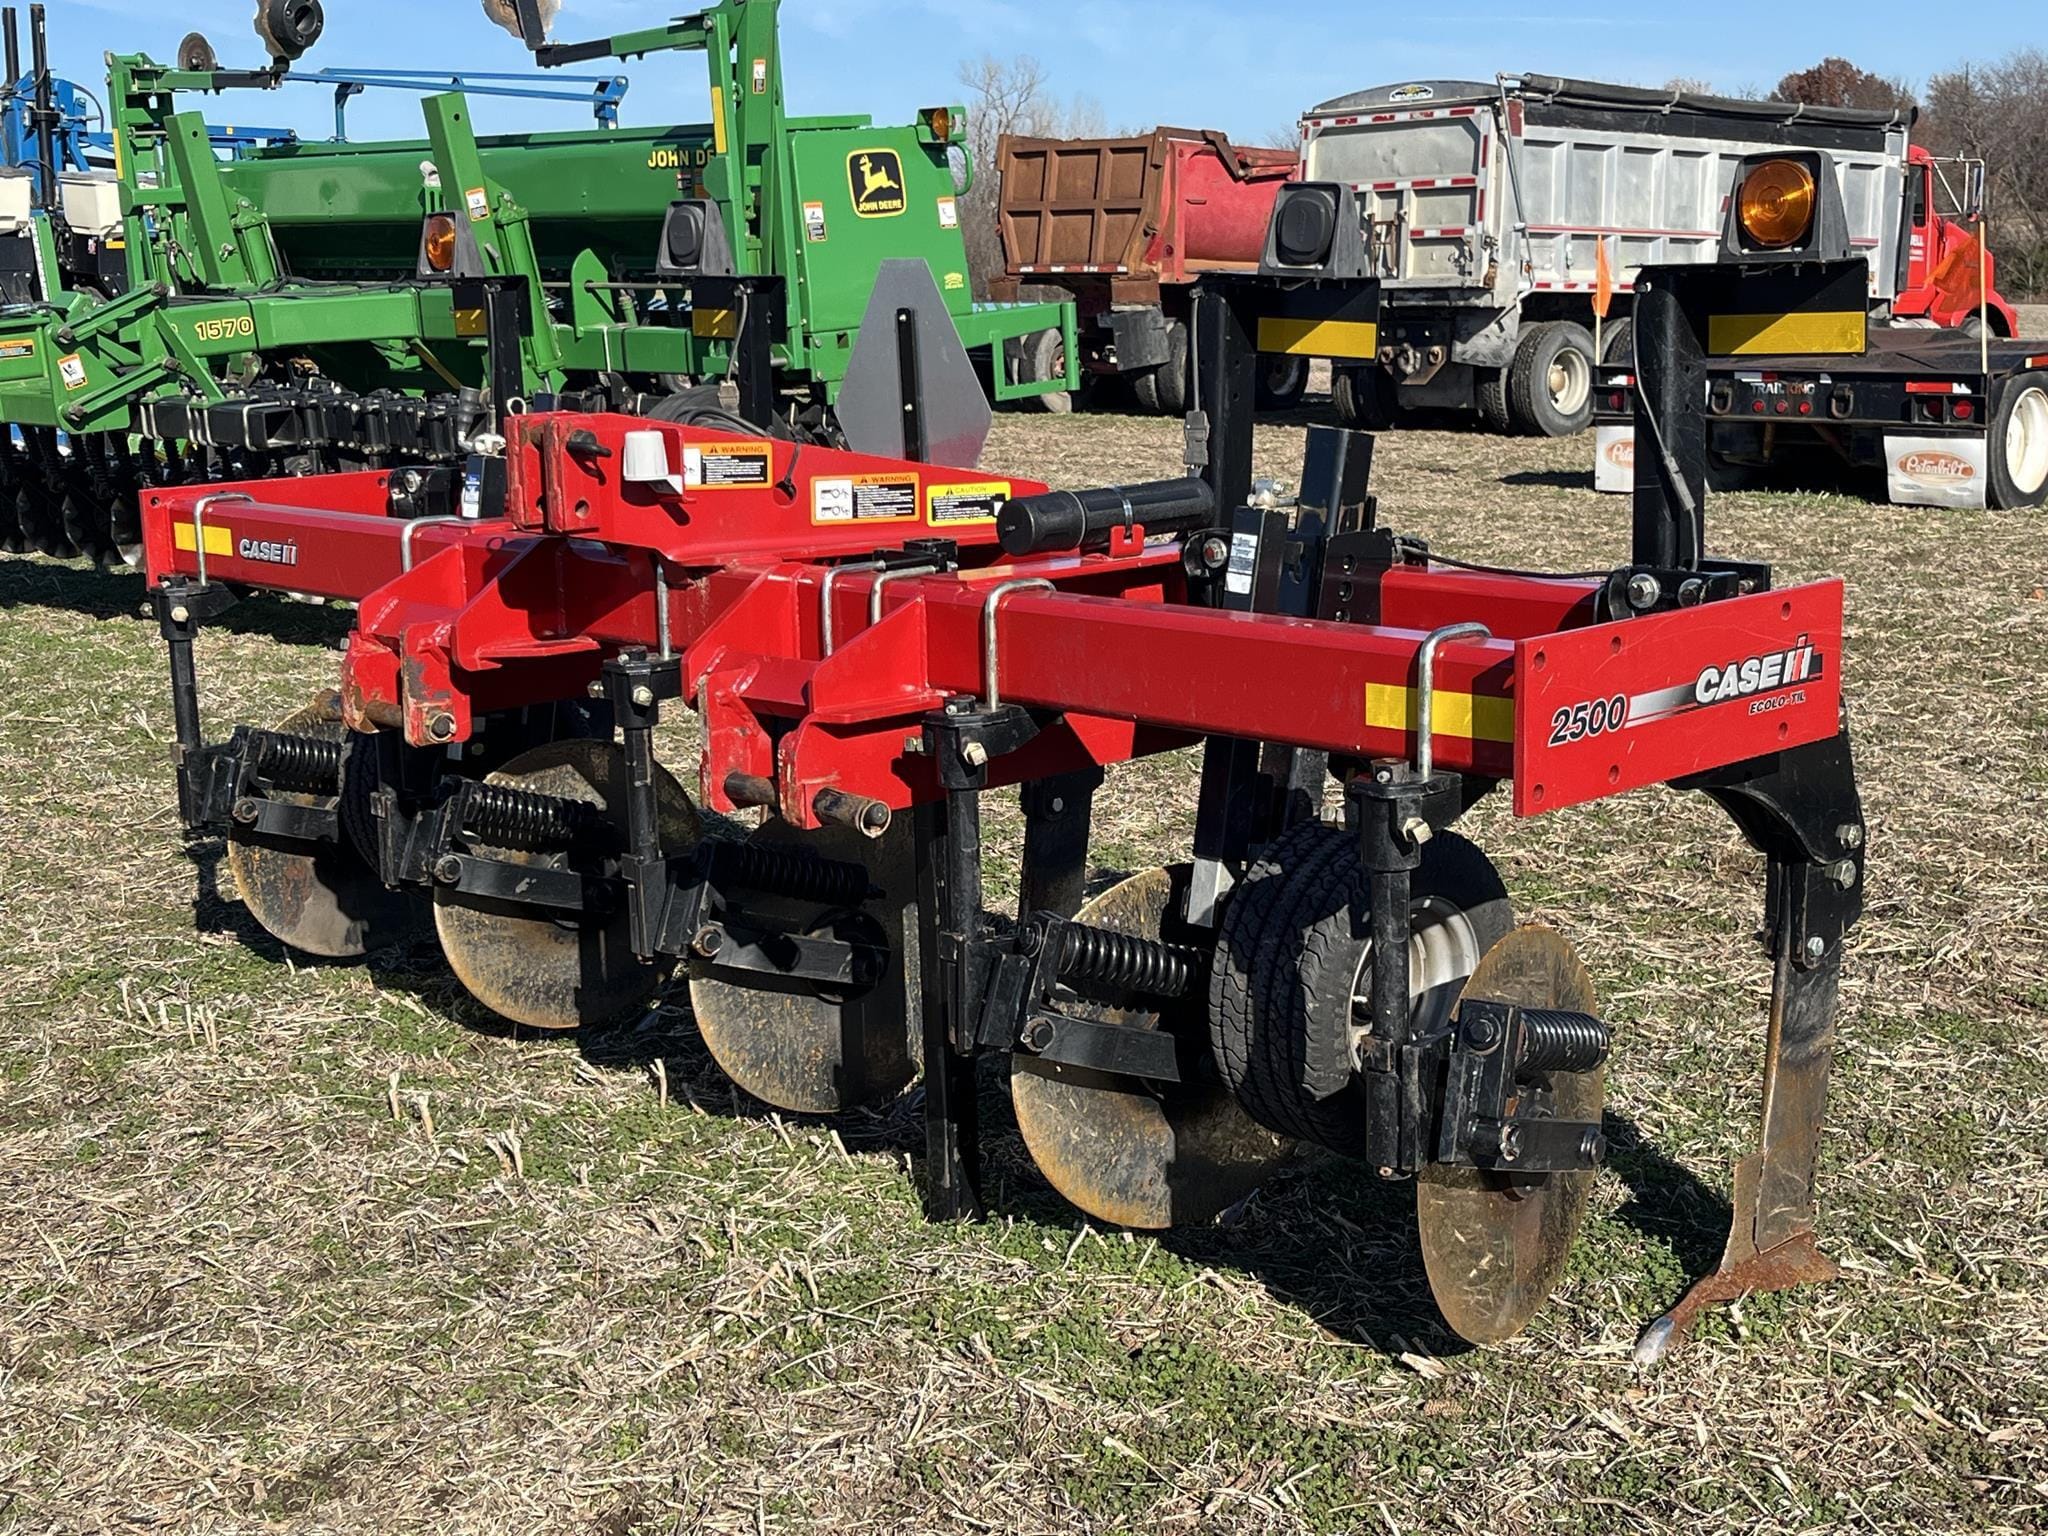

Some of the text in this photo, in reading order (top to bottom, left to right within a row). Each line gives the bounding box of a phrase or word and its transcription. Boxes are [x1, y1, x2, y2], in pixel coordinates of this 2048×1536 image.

[647, 150, 690, 168] JOHN
[858, 199, 902, 212] JOHN DEERE
[195, 316, 254, 341] 1570
[1750, 382, 1784, 395] TRAIL
[721, 446, 764, 454] WARNING
[1906, 455, 1966, 476] Peterbilt
[870, 475, 912, 484] WARNING
[954, 486, 987, 495] CAUTION
[1549, 694, 1627, 747] 2500
